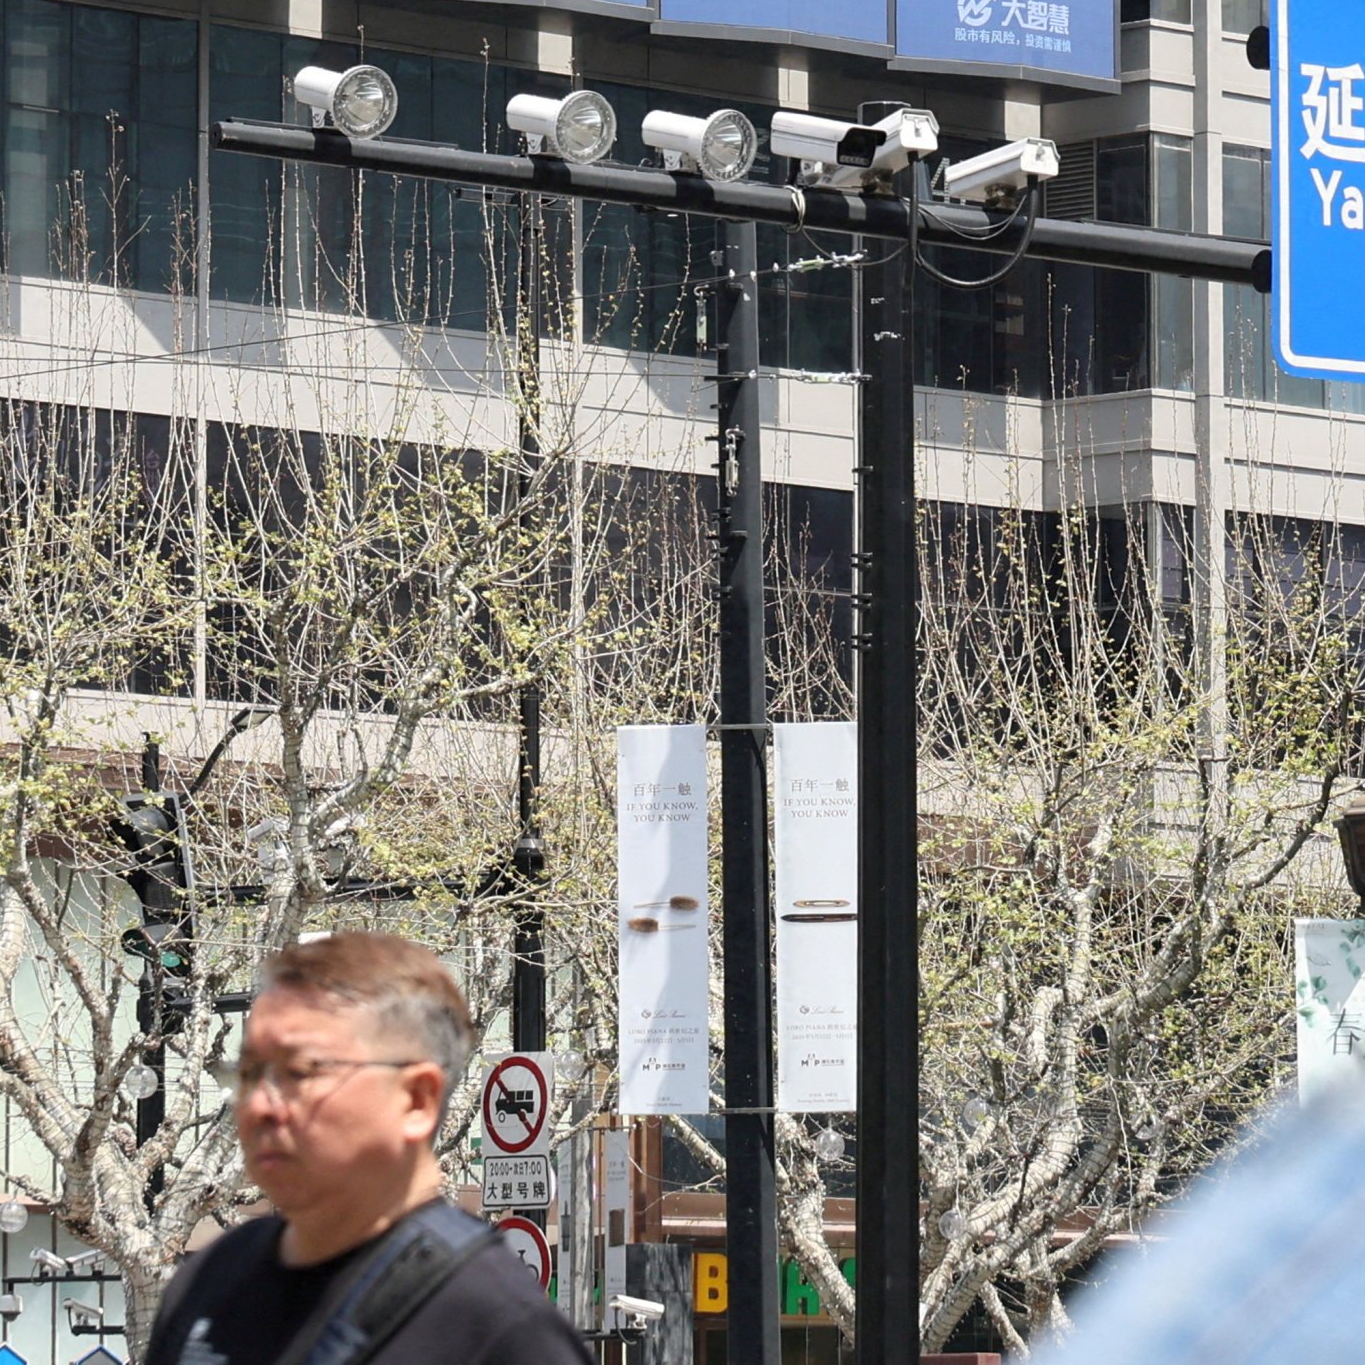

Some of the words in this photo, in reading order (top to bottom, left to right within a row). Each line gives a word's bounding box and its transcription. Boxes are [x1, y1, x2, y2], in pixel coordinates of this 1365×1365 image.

[634, 782, 691, 797] 百年一触
[790, 778, 849, 792] 百年一触
[626, 803, 635, 811] IF
[663, 802, 699, 811] KNOW,
[784, 798, 794, 806] IF
[796, 798, 818, 806] YOU
[634, 814, 655, 822] YOU
[658, 814, 691, 822] KNOW
[791, 810, 812, 818] YOU
[815, 810, 849, 818] KNOW
[487, 1182, 546, 1200] 大型号牌
